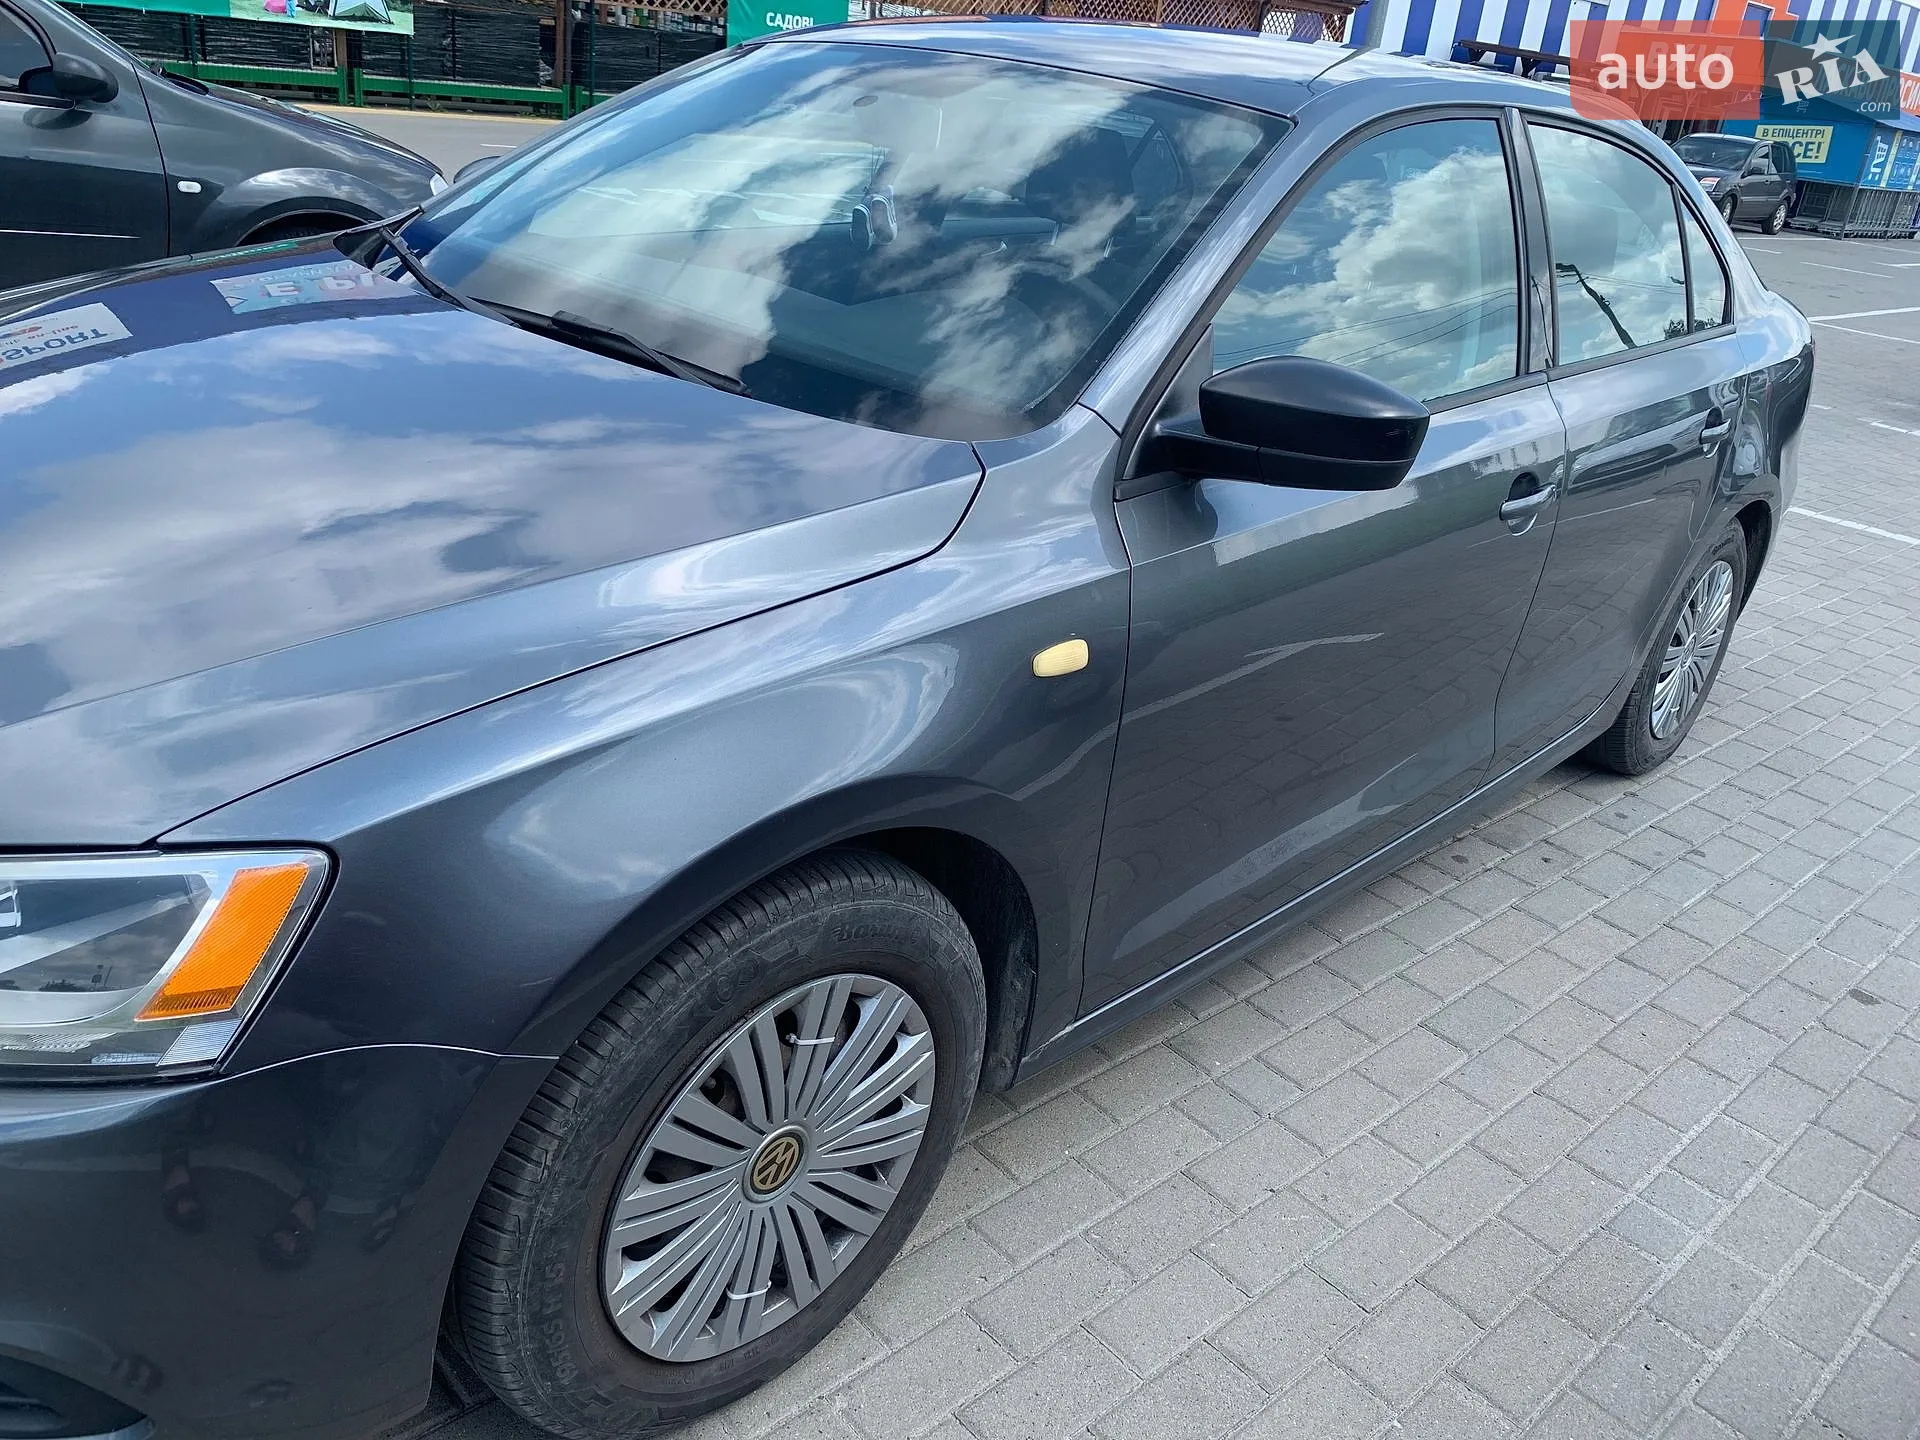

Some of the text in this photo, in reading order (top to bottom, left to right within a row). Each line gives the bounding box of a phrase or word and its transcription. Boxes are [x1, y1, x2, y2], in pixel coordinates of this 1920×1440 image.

[766, 12, 813, 30] САДОВІ
[1762, 128, 1825, 140] В ЕПІЦЕНТРІ
[1791, 141, 1824, 159] СЕ!
